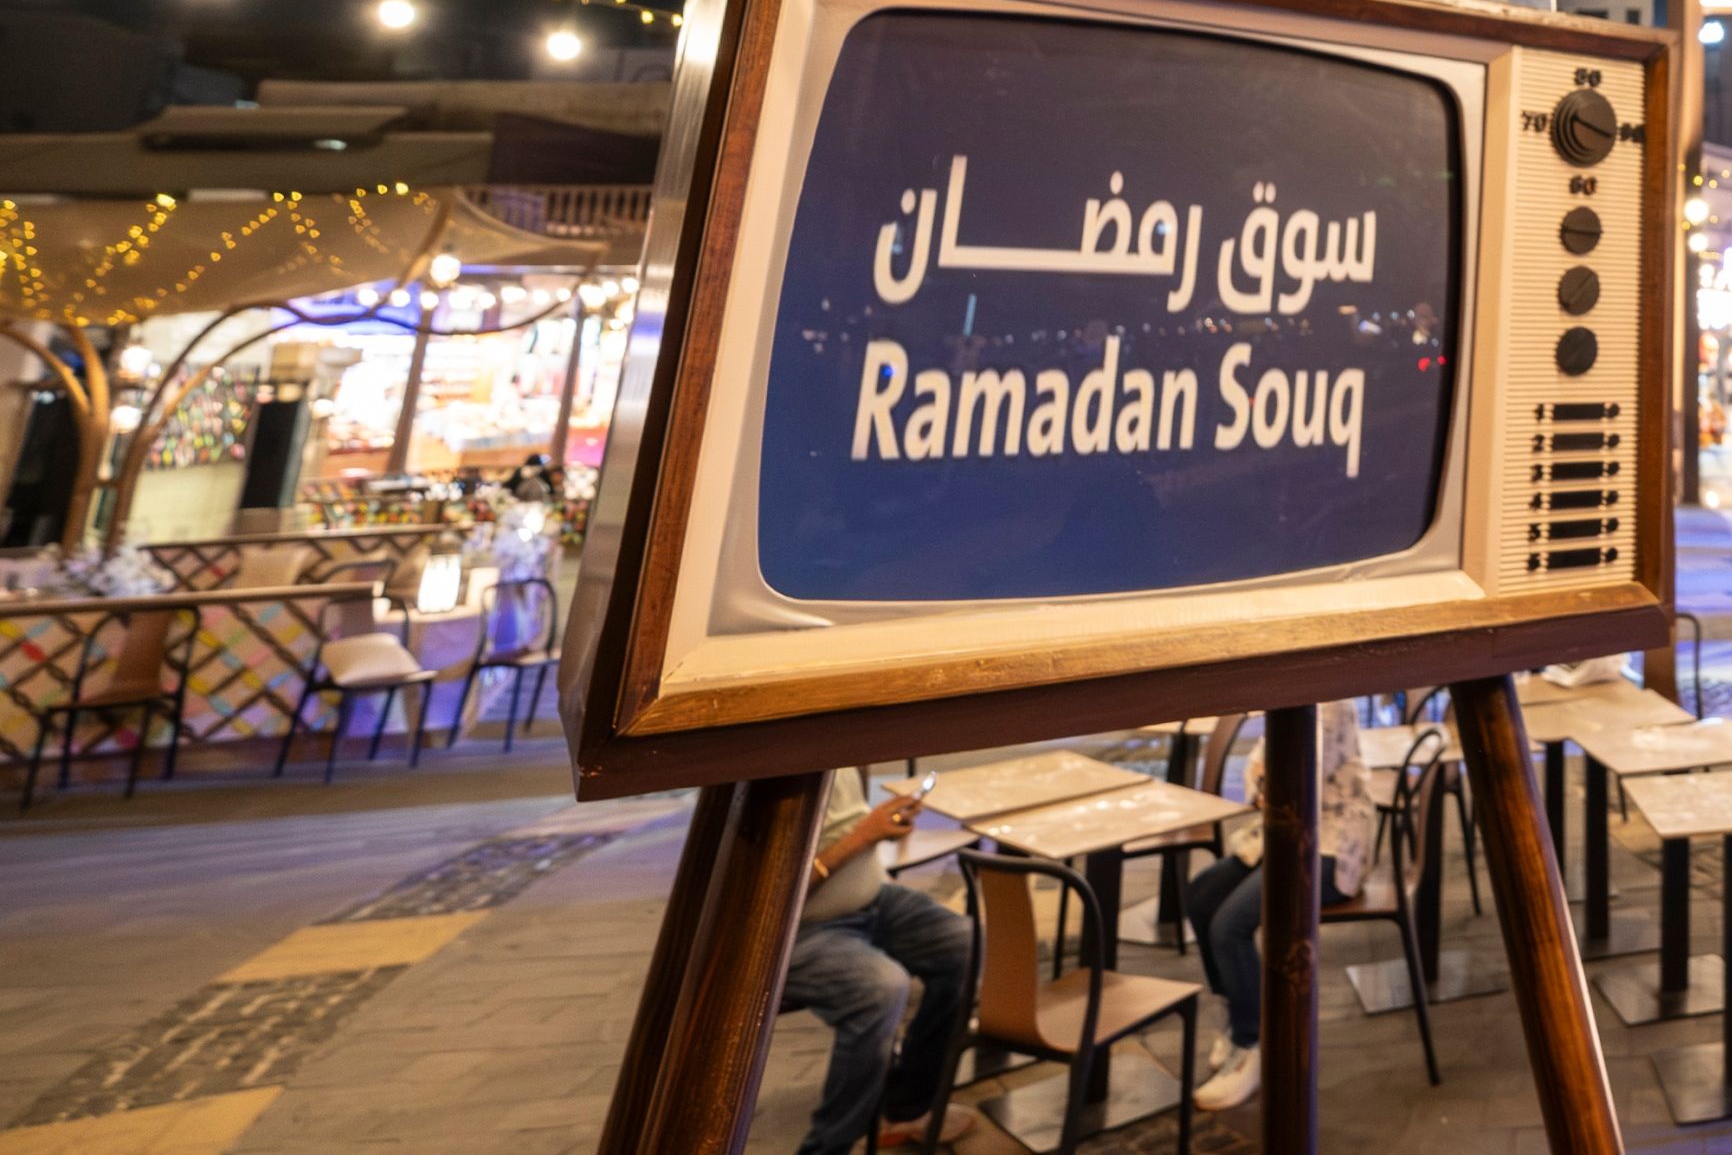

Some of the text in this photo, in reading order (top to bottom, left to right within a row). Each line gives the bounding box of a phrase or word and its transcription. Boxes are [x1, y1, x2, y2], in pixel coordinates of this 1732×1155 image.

[873, 154, 1377, 315] سوق رمضان
[850, 334, 1365, 479] Ramadan Souq
